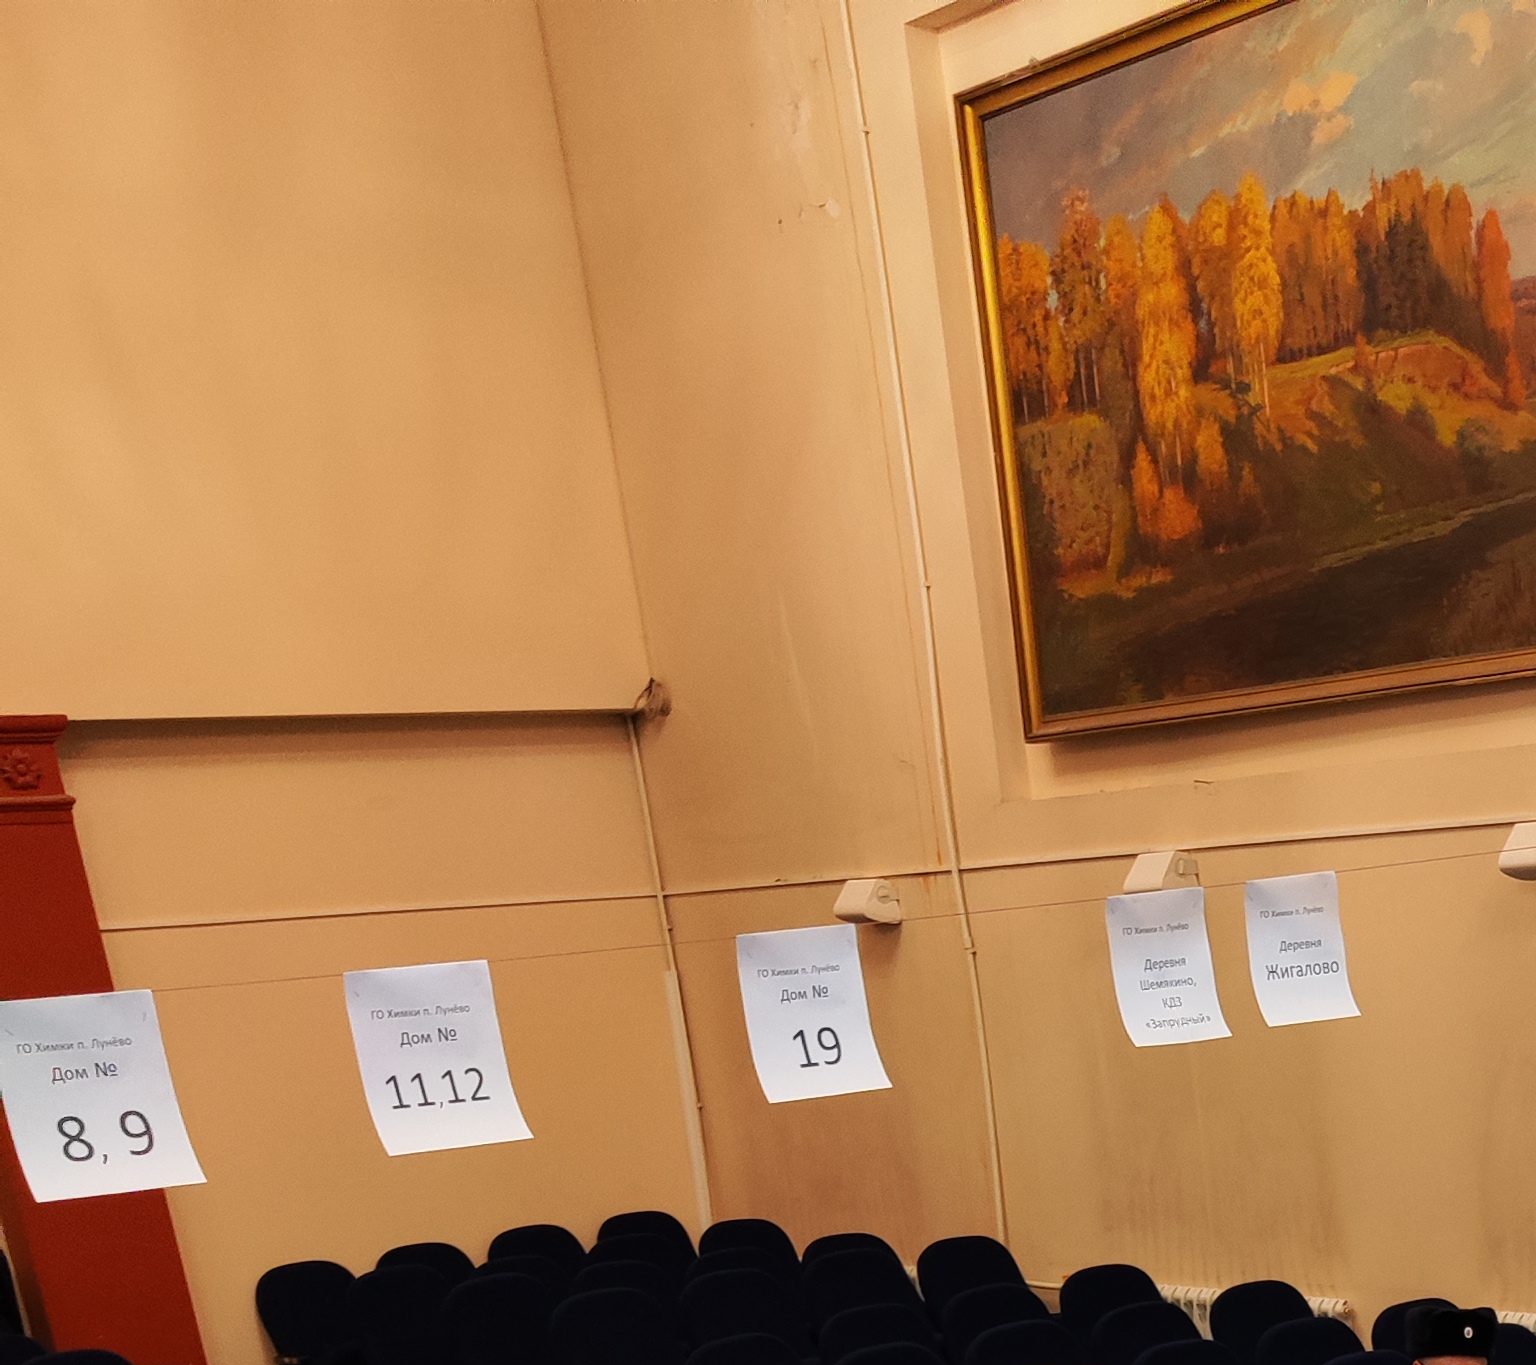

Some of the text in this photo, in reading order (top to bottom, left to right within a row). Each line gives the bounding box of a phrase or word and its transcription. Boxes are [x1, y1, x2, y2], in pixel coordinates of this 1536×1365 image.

[1259, 910, 1270, 919] ГО
[1122, 926, 1133, 936] ГО
[1279, 939, 1322, 953] Деревня
[757, 968, 769, 978] ГО
[770, 967, 799, 977] Химки
[810, 963, 840, 975] Лунёво
[1143, 957, 1187, 973] Деревня
[1265, 960, 1340, 981] Жигалово
[1139, 976, 1197, 991] Шемякино,
[780, 984, 829, 1004] Дом №
[371, 1010, 384, 1020] ГО
[387, 1008, 421, 1019] Химки
[435, 1004, 471, 1017] Лунёво
[1145, 1013, 1211, 1029] «Запрудный»
[16, 1043, 32, 1054] ГО
[36, 1041, 74, 1053] Химки
[91, 1036, 133, 1050] Лунёво
[400, 1027, 458, 1048] Дом №
[792, 1026, 842, 1069] 19
[51, 1061, 118, 1084] Дом №
[385, 1067, 491, 1110] 11,12
[57, 1110, 154, 1165] 8, 9
